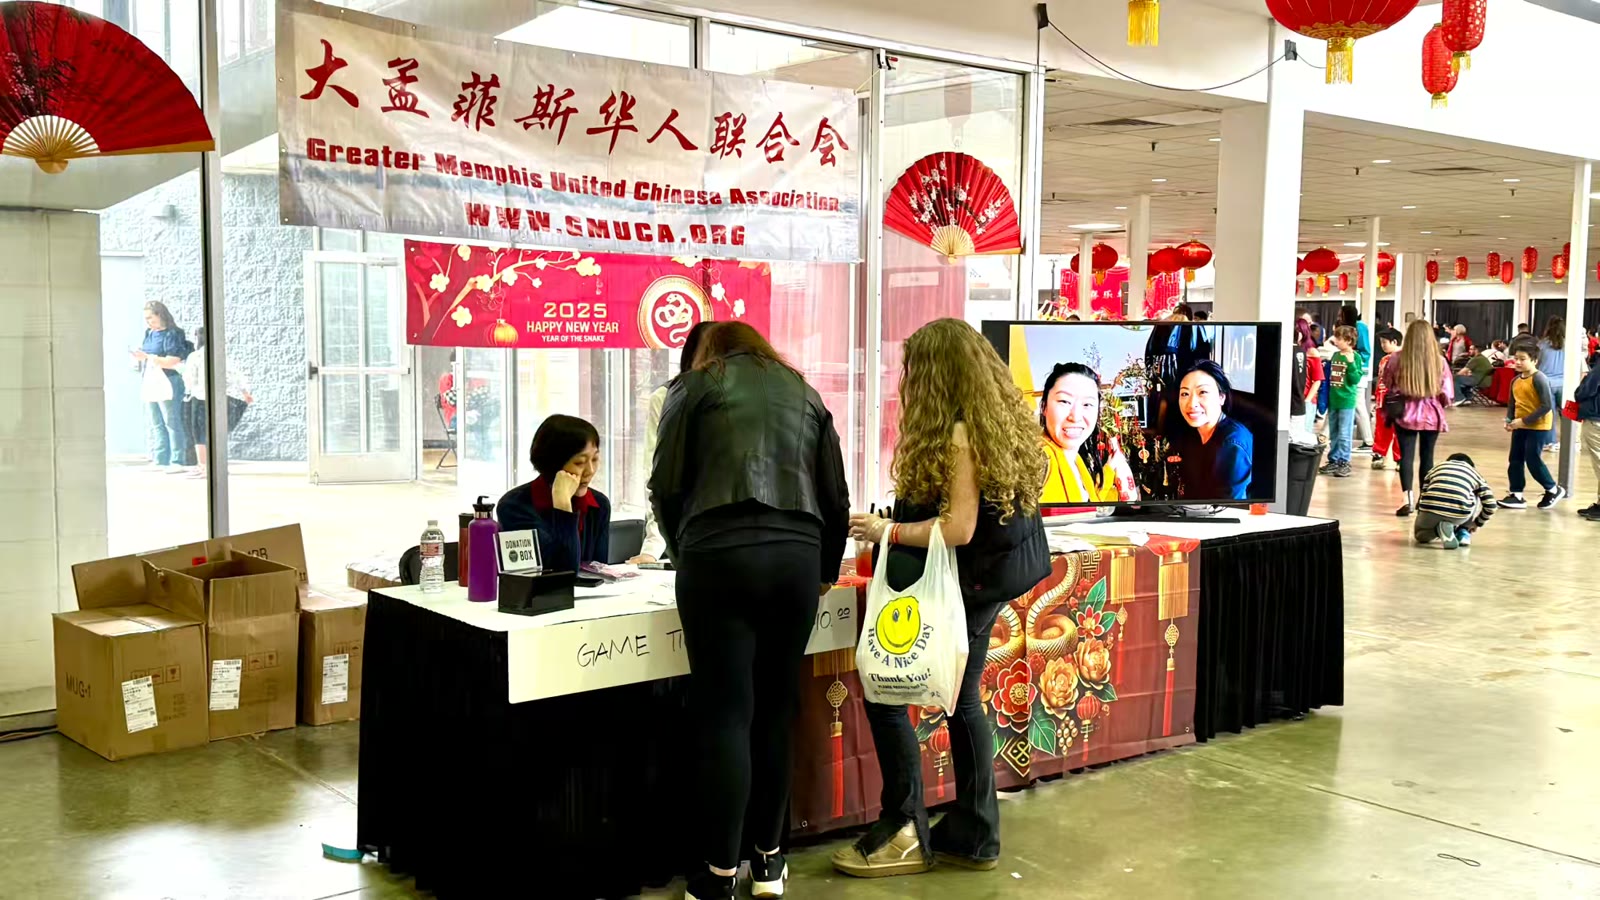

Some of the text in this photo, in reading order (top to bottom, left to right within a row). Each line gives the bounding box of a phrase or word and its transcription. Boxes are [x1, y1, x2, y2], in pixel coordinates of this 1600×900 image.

[300, 38, 849, 167] 大孟菲斯华人联合会
[306, 137, 839, 212] Greater Memphis United Chinese Association
[464, 202, 745, 246] WWW.GMUCA.ORG
[543, 302, 608, 318] 2025
[527, 321, 619, 333] HAPPY NEW YEAR
[505, 539, 532, 550] DONATION
[519, 550, 534, 561] BOX
[577, 635, 650, 667] GAME
[666, 629, 684, 652] TI
[867, 623, 935, 669] Have A Nice Day
[868, 667, 932, 683] Thank You!
